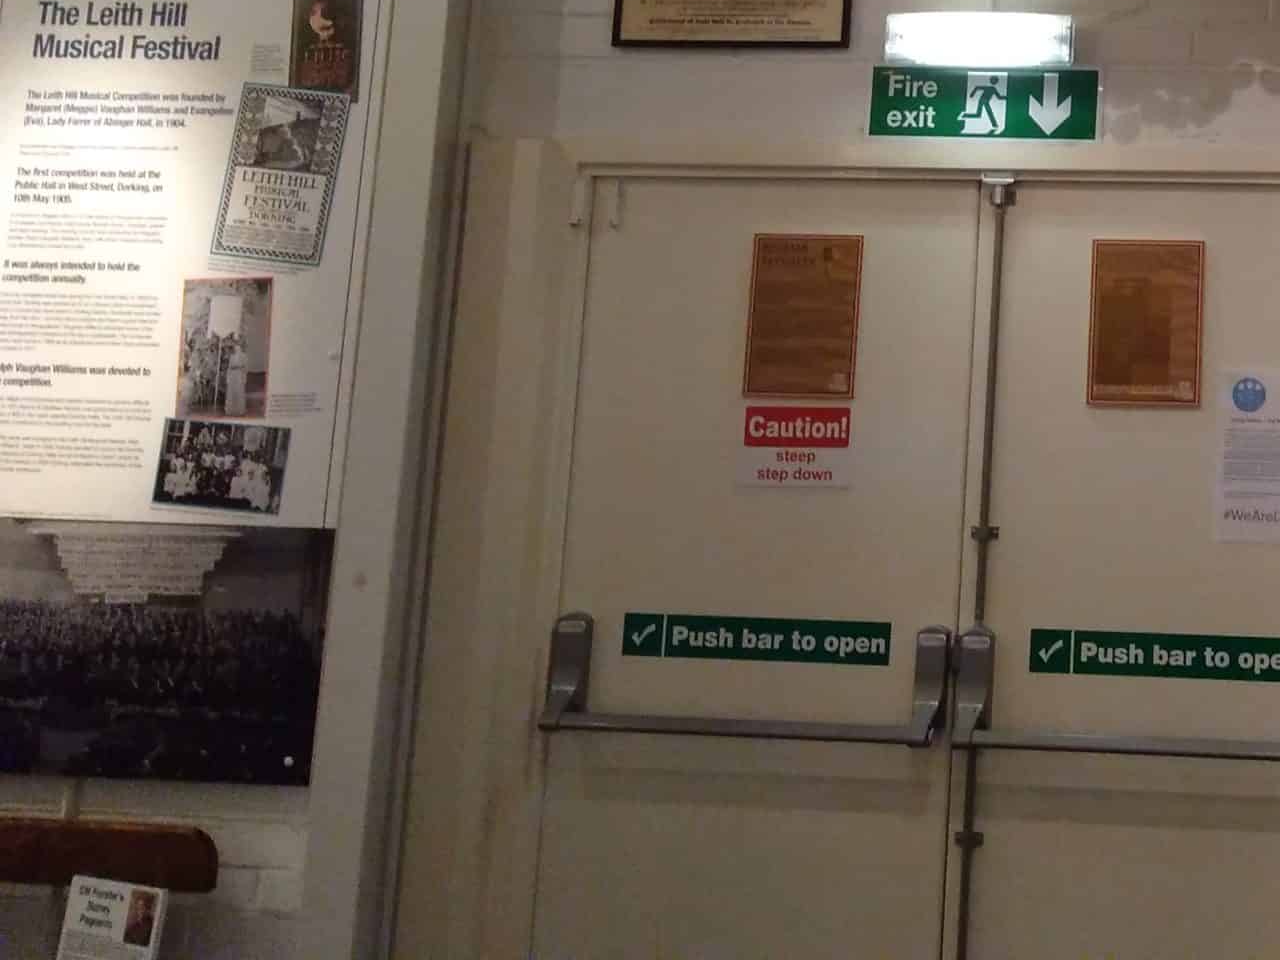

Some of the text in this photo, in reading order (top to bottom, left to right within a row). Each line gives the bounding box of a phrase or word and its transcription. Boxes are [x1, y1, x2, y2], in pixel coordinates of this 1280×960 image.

[38, 1, 187, 27] The Leith Hill
[32, 34, 221, 60] Musical Festival
[888, 75, 938, 97] Fire
[27, 90, 42, 100] The
[43, 90, 63, 100] Leith
[65, 91, 78, 100] Hill
[80, 91, 111, 101] Musical
[112, 91, 160, 103] Competition
[181, 93, 214, 102] founded
[26, 104, 62, 115] Margaret
[100, 104, 135, 115] Vaughan
[137, 104, 170, 114] Williams
[174, 106, 188, 114] and
[886, 105, 935, 128] exit
[47, 117, 65, 128] Lady
[17, 167, 31, 176] The
[33, 167, 49, 176] first
[51, 168, 98, 178] competition
[118, 169, 136, 178] held
[137, 170, 146, 178] at
[148, 170, 160, 178] the
[15, 180, 38, 189] Public
[41, 180, 56, 189] Hall
[68, 180, 87, 190] West
[32, 194, 49, 204] May
[30, 261, 58, 271] always
[61, 261, 96, 270] intended
[97, 262, 105, 270] to
[107, 262, 125, 270] hold
[127, 262, 140, 271] the
[2, 273, 49, 283] competition
[16, 363, 51, 374] Vaughan
[53, 364, 87, 374] Williams
[108, 366, 141, 375] devoted
[143, 367, 151, 376] to
[750, 416, 847, 439] Caution!
[776, 450, 816, 465] steep
[758, 467, 832, 482] step down
[671, 626, 886, 657] Push bar to open
[1079, 642, 1144, 664] Push
[1152, 645, 1196, 666] bar
[1203, 647, 1230, 668] to
